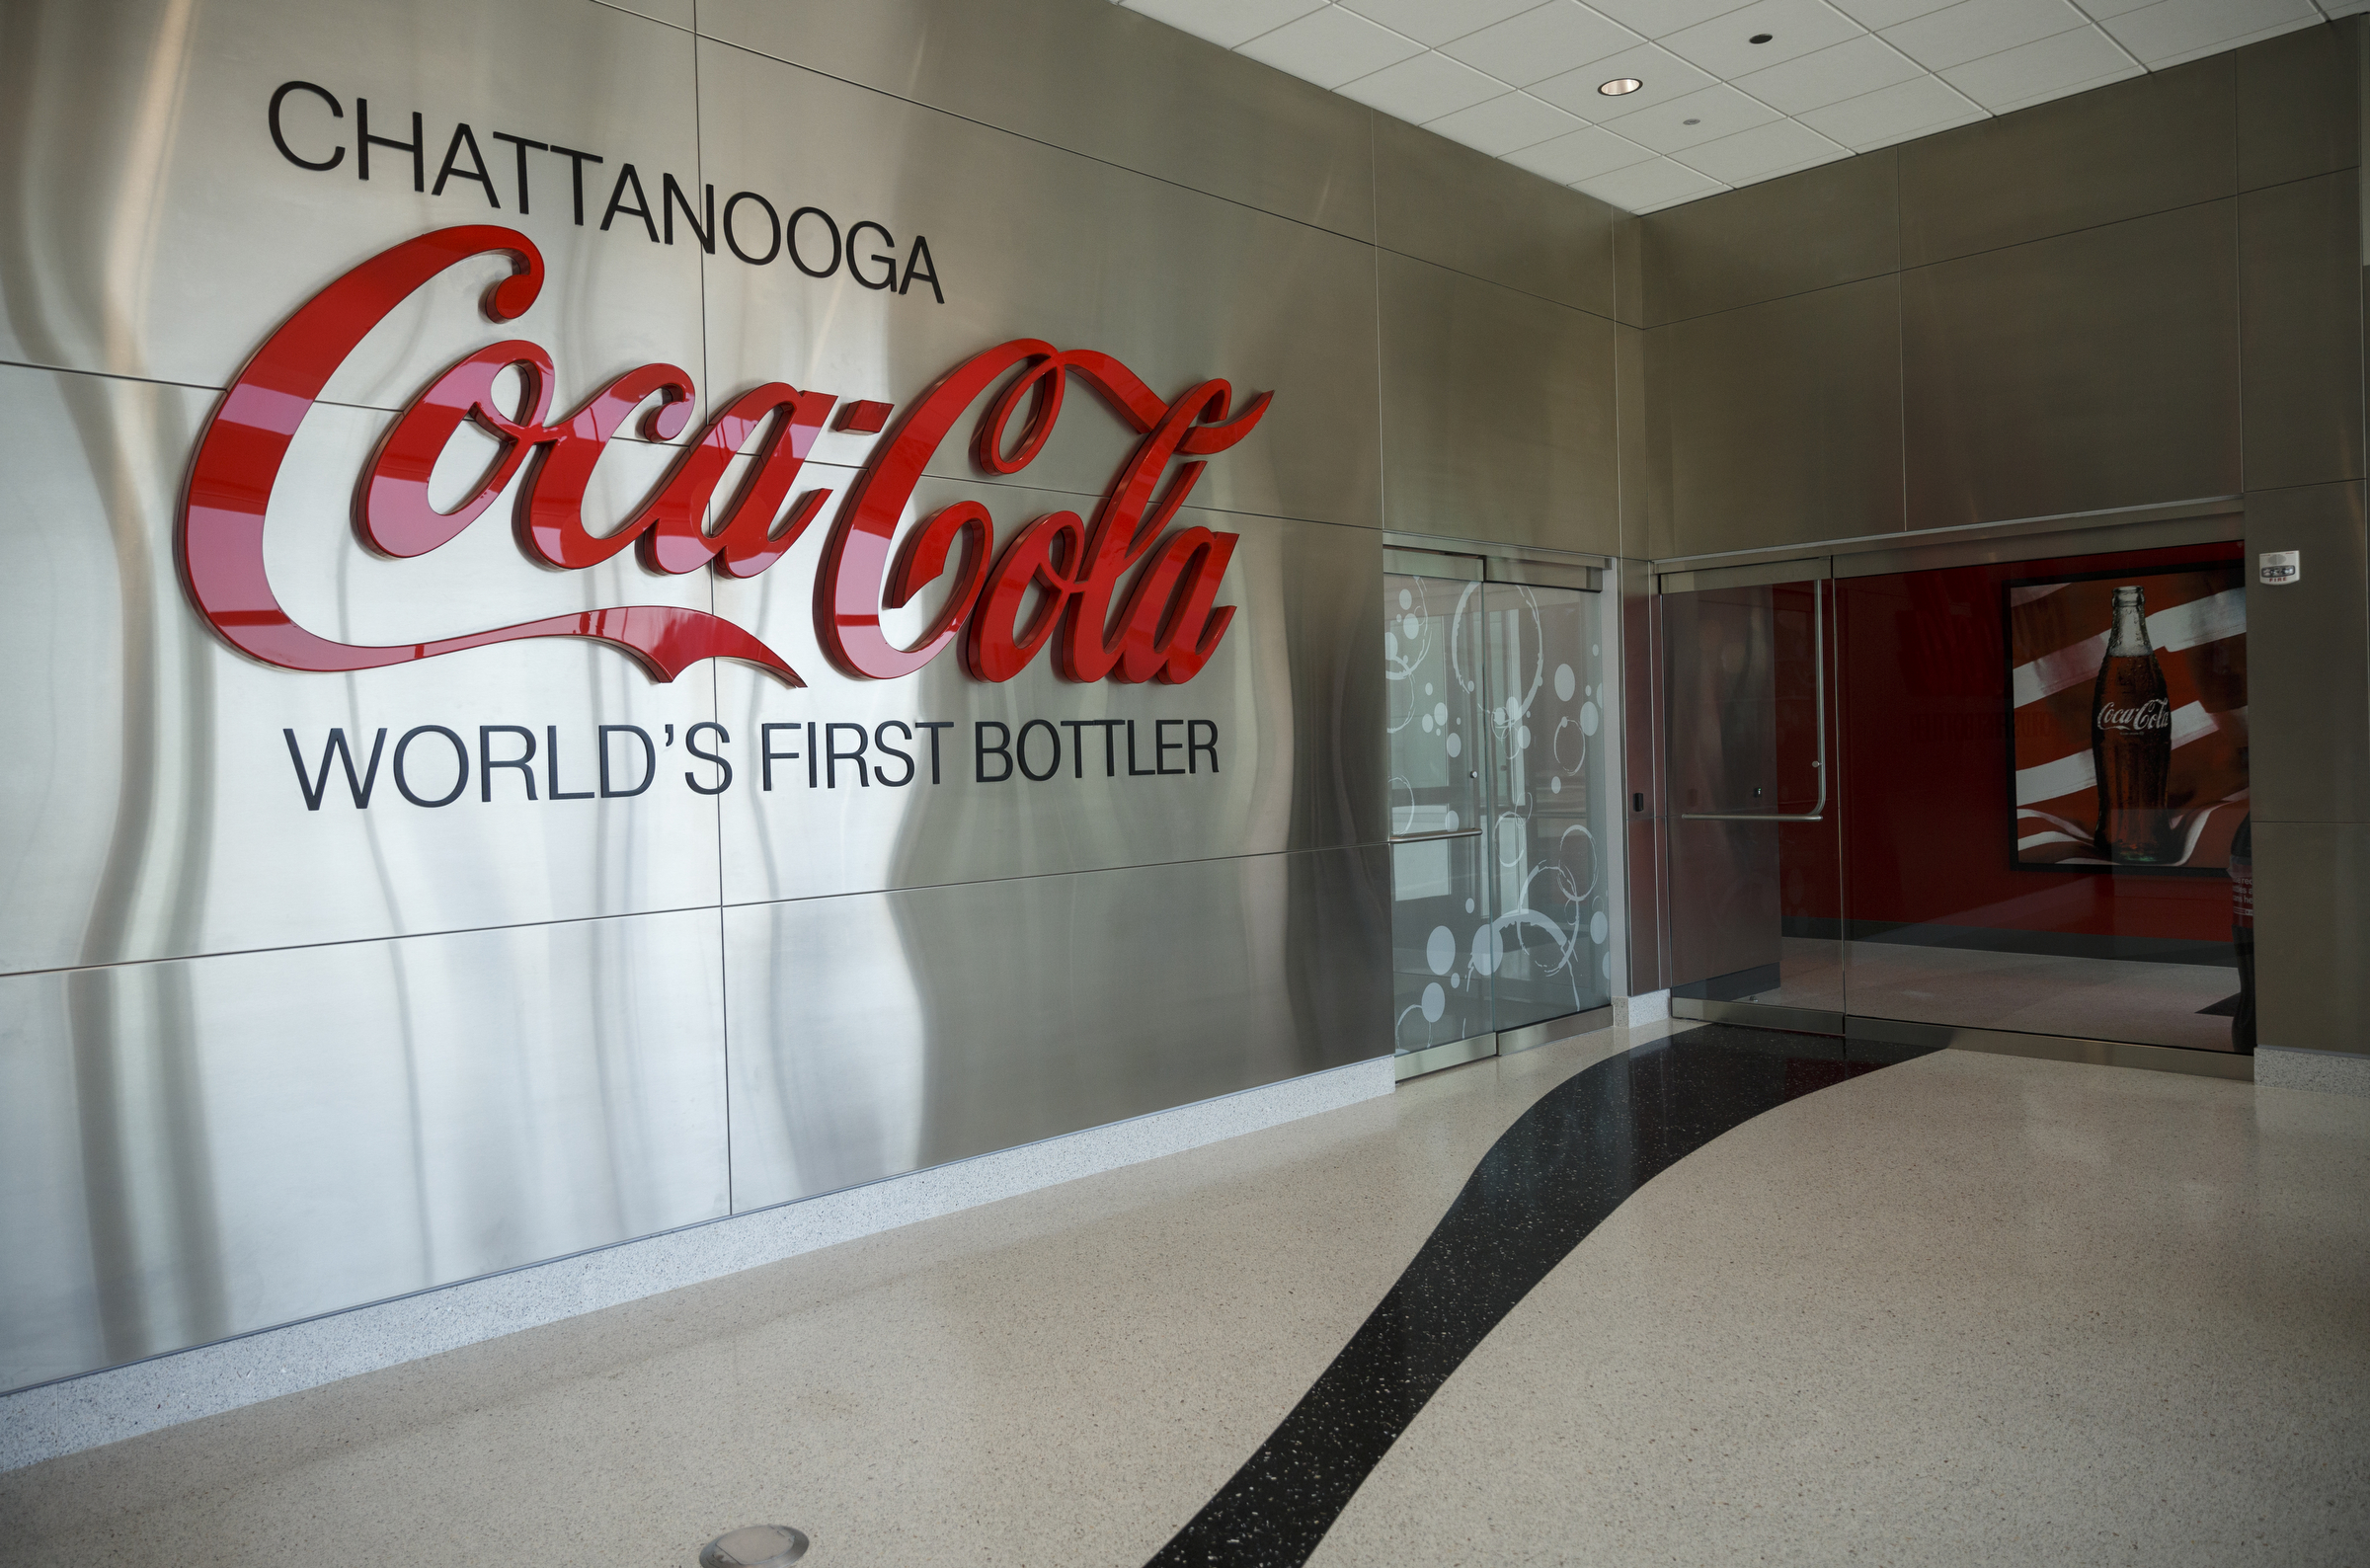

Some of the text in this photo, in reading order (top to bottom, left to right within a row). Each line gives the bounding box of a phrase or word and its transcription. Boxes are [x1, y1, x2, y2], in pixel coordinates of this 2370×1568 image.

[268, 80, 945, 304] CHATTANOOGA
[178, 223, 1274, 688] Coca-Cola
[283, 719, 1220, 811] WORLD'S FIRST BOTTLER
[2096, 696, 2170, 731] Coca-Cola
